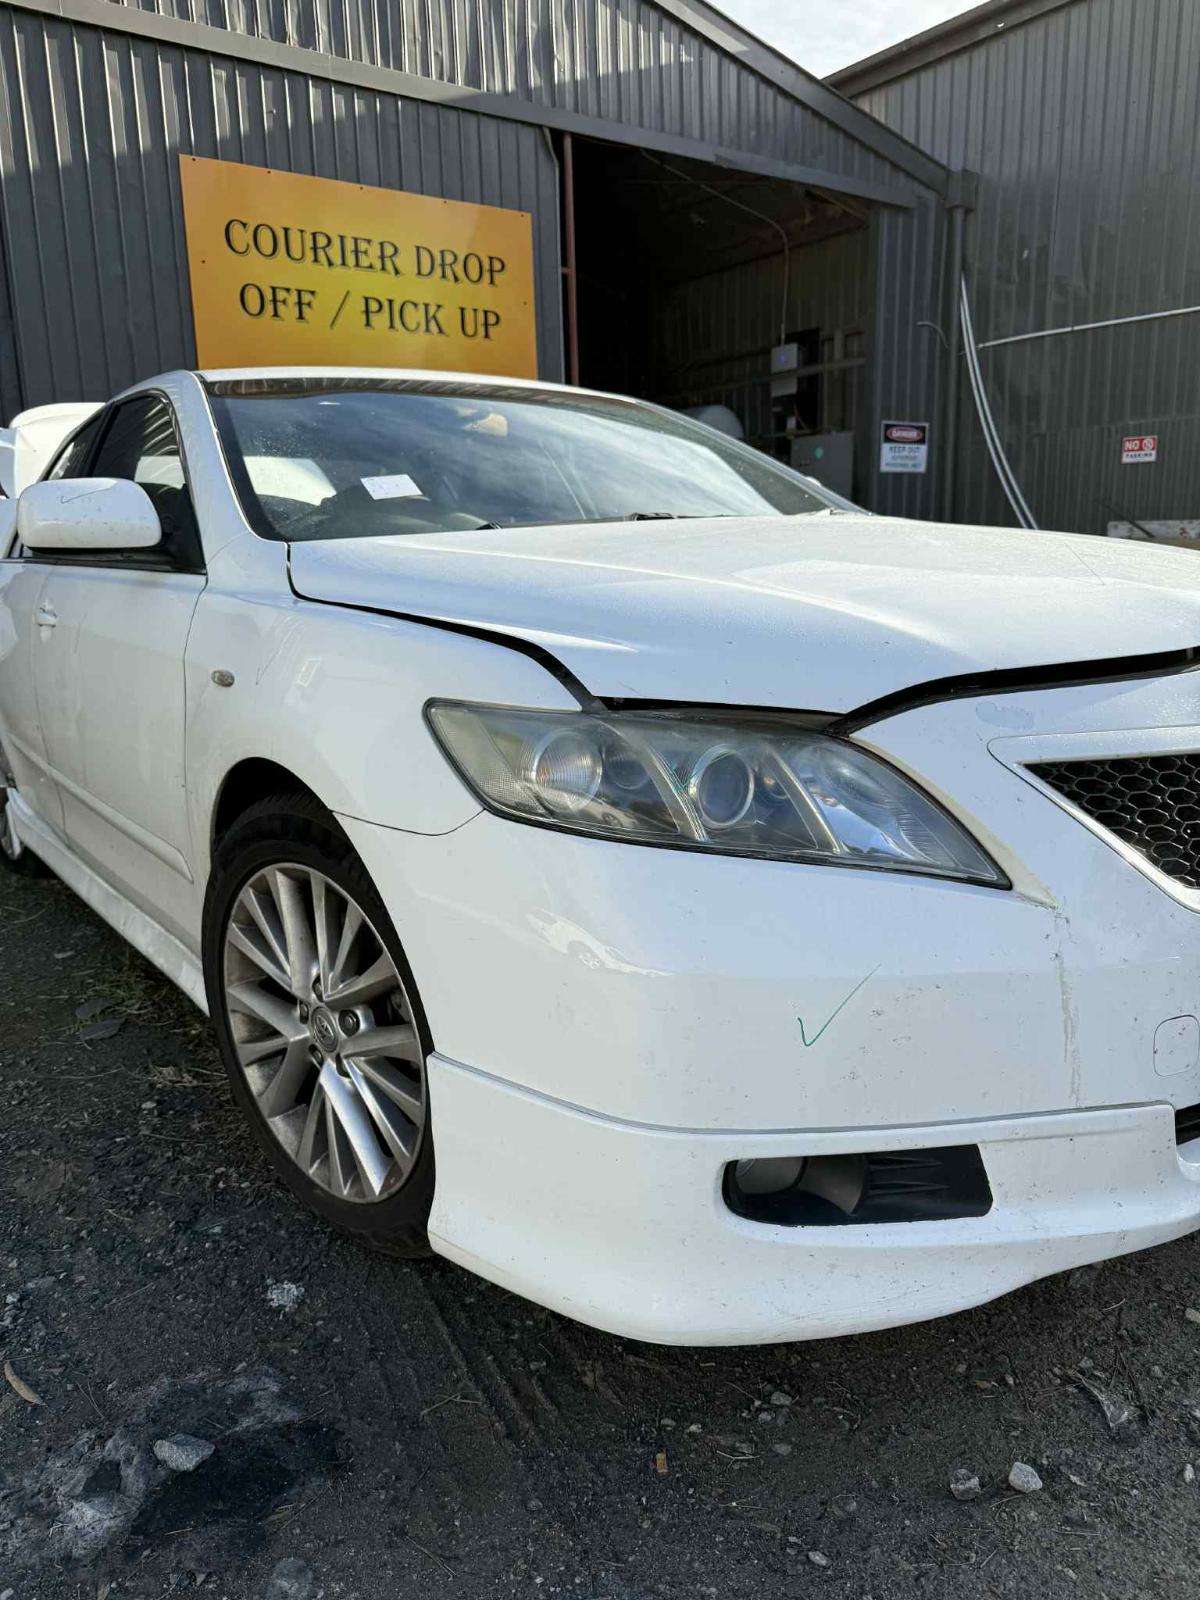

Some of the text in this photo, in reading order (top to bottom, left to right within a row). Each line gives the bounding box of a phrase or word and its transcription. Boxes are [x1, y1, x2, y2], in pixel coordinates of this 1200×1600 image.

[224, 219, 506, 287] COURIER DROP
[239, 283, 502, 340] OFF / PICK UP
[1125, 440, 1140, 450] NO
